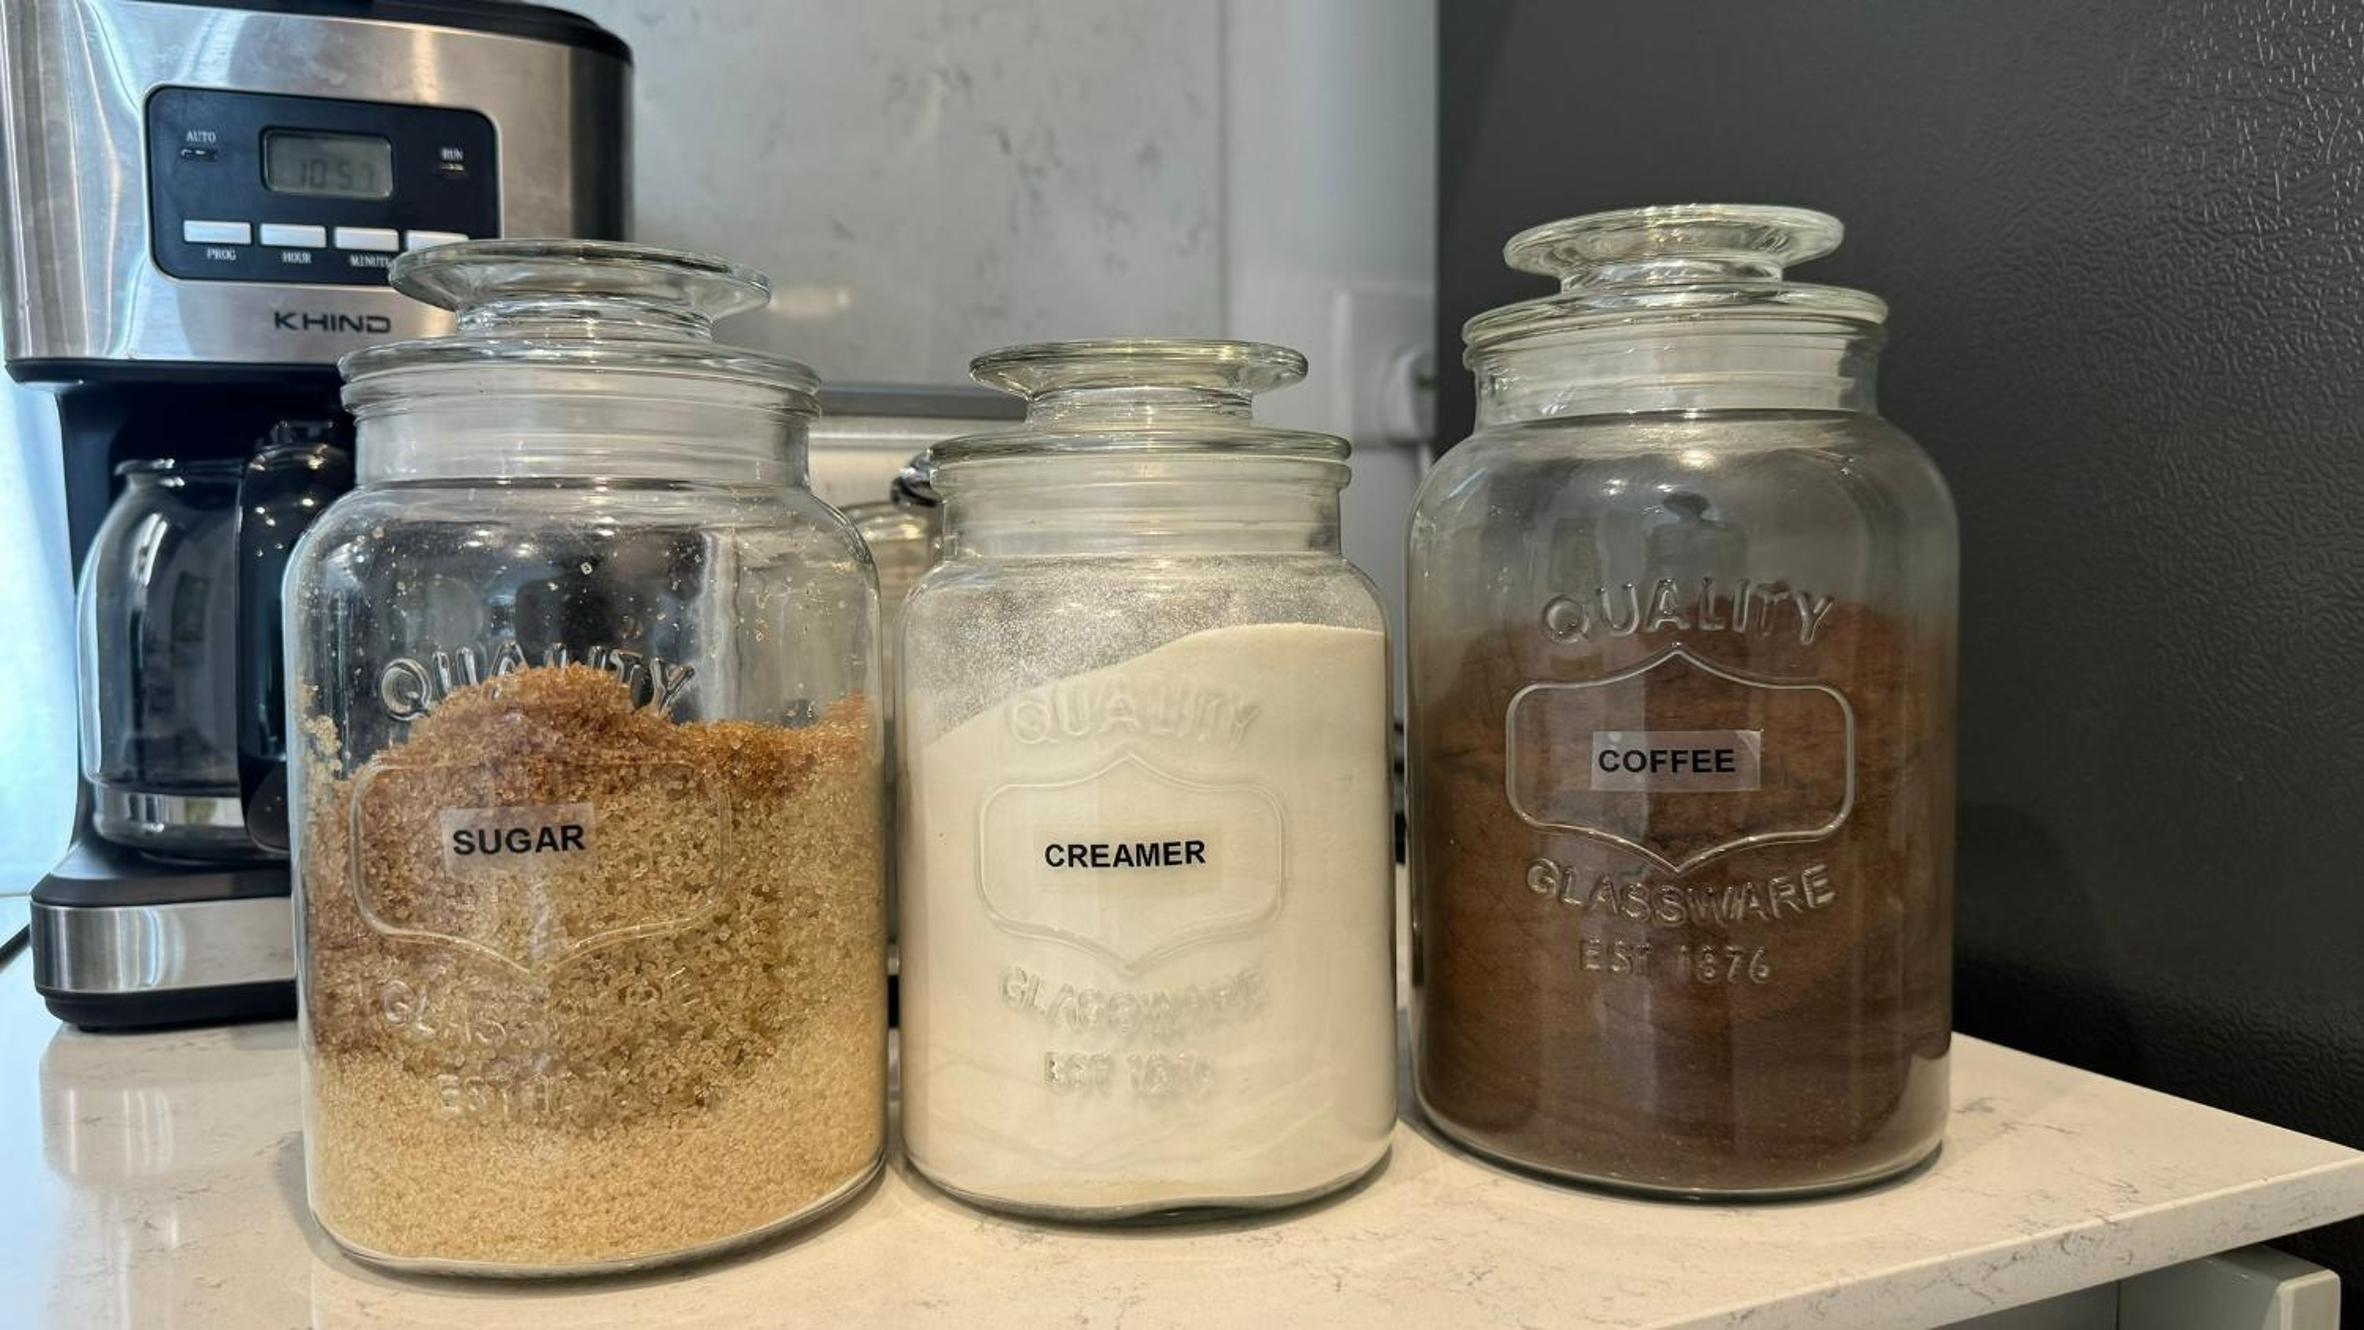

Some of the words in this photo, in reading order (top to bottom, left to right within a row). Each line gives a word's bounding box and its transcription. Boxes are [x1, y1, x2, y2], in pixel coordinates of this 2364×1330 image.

[186, 129, 217, 144] AUTO
[206, 247, 237, 261] PROG
[282, 250, 312, 264] HOUR
[273, 310, 392, 335] KHIND
[1541, 576, 1837, 646] QUALITY
[1003, 672, 1264, 750] QUALITY
[1597, 748, 1737, 775] COFFEE
[452, 823, 586, 857] SUGAR
[1044, 840, 1207, 869] CREAMER
[1526, 857, 1837, 928] GLASSWARE
[1580, 936, 1652, 975] EST
[1675, 945, 1771, 985] 1876
